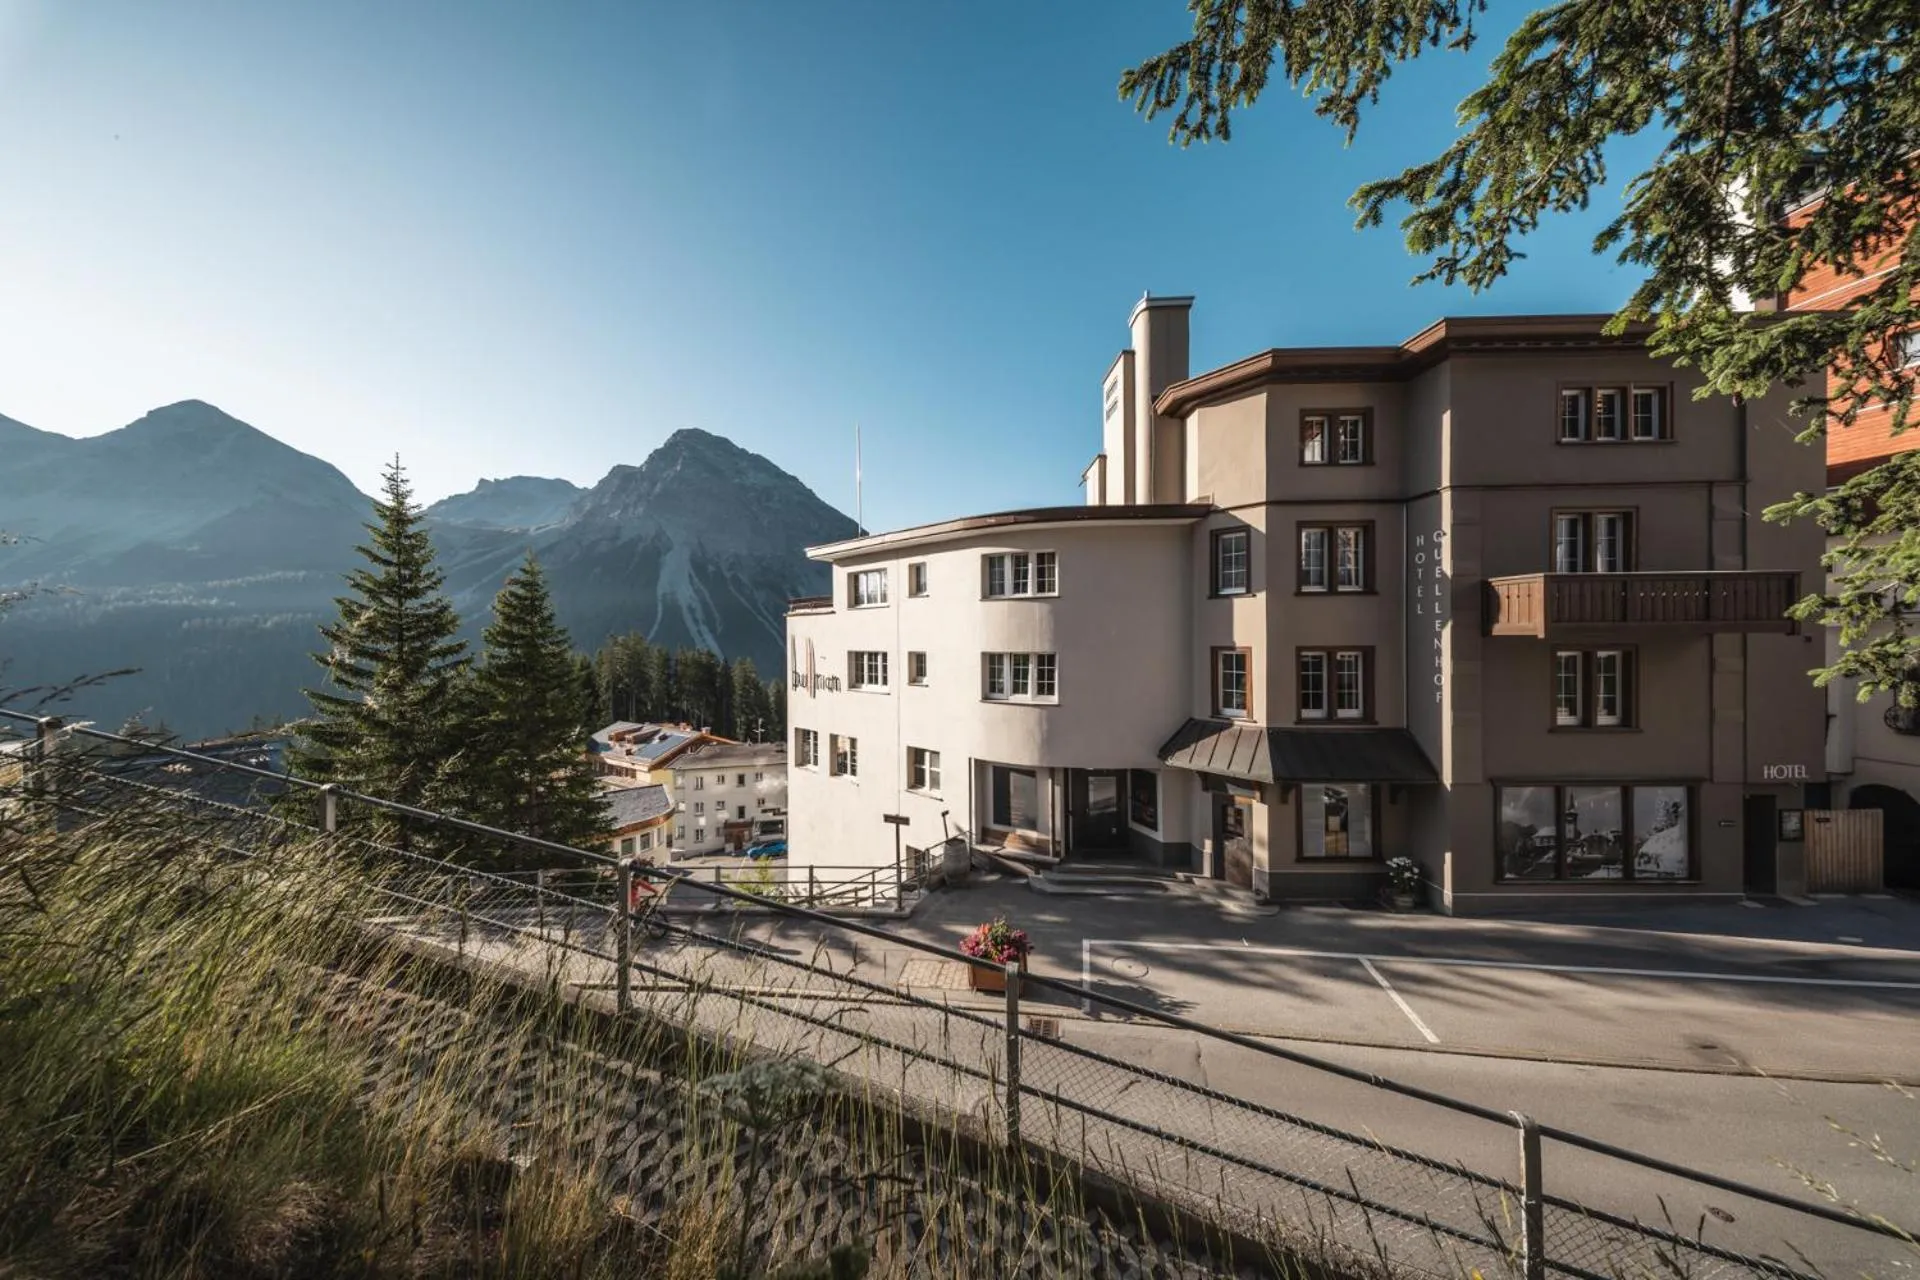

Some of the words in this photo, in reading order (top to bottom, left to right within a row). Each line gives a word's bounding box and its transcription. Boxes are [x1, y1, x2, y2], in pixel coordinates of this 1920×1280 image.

[1415, 535, 1425, 614] HOTEL
[1433, 530, 1445, 702] QUELLENHOF
[1763, 764, 1808, 779] HOTEL
